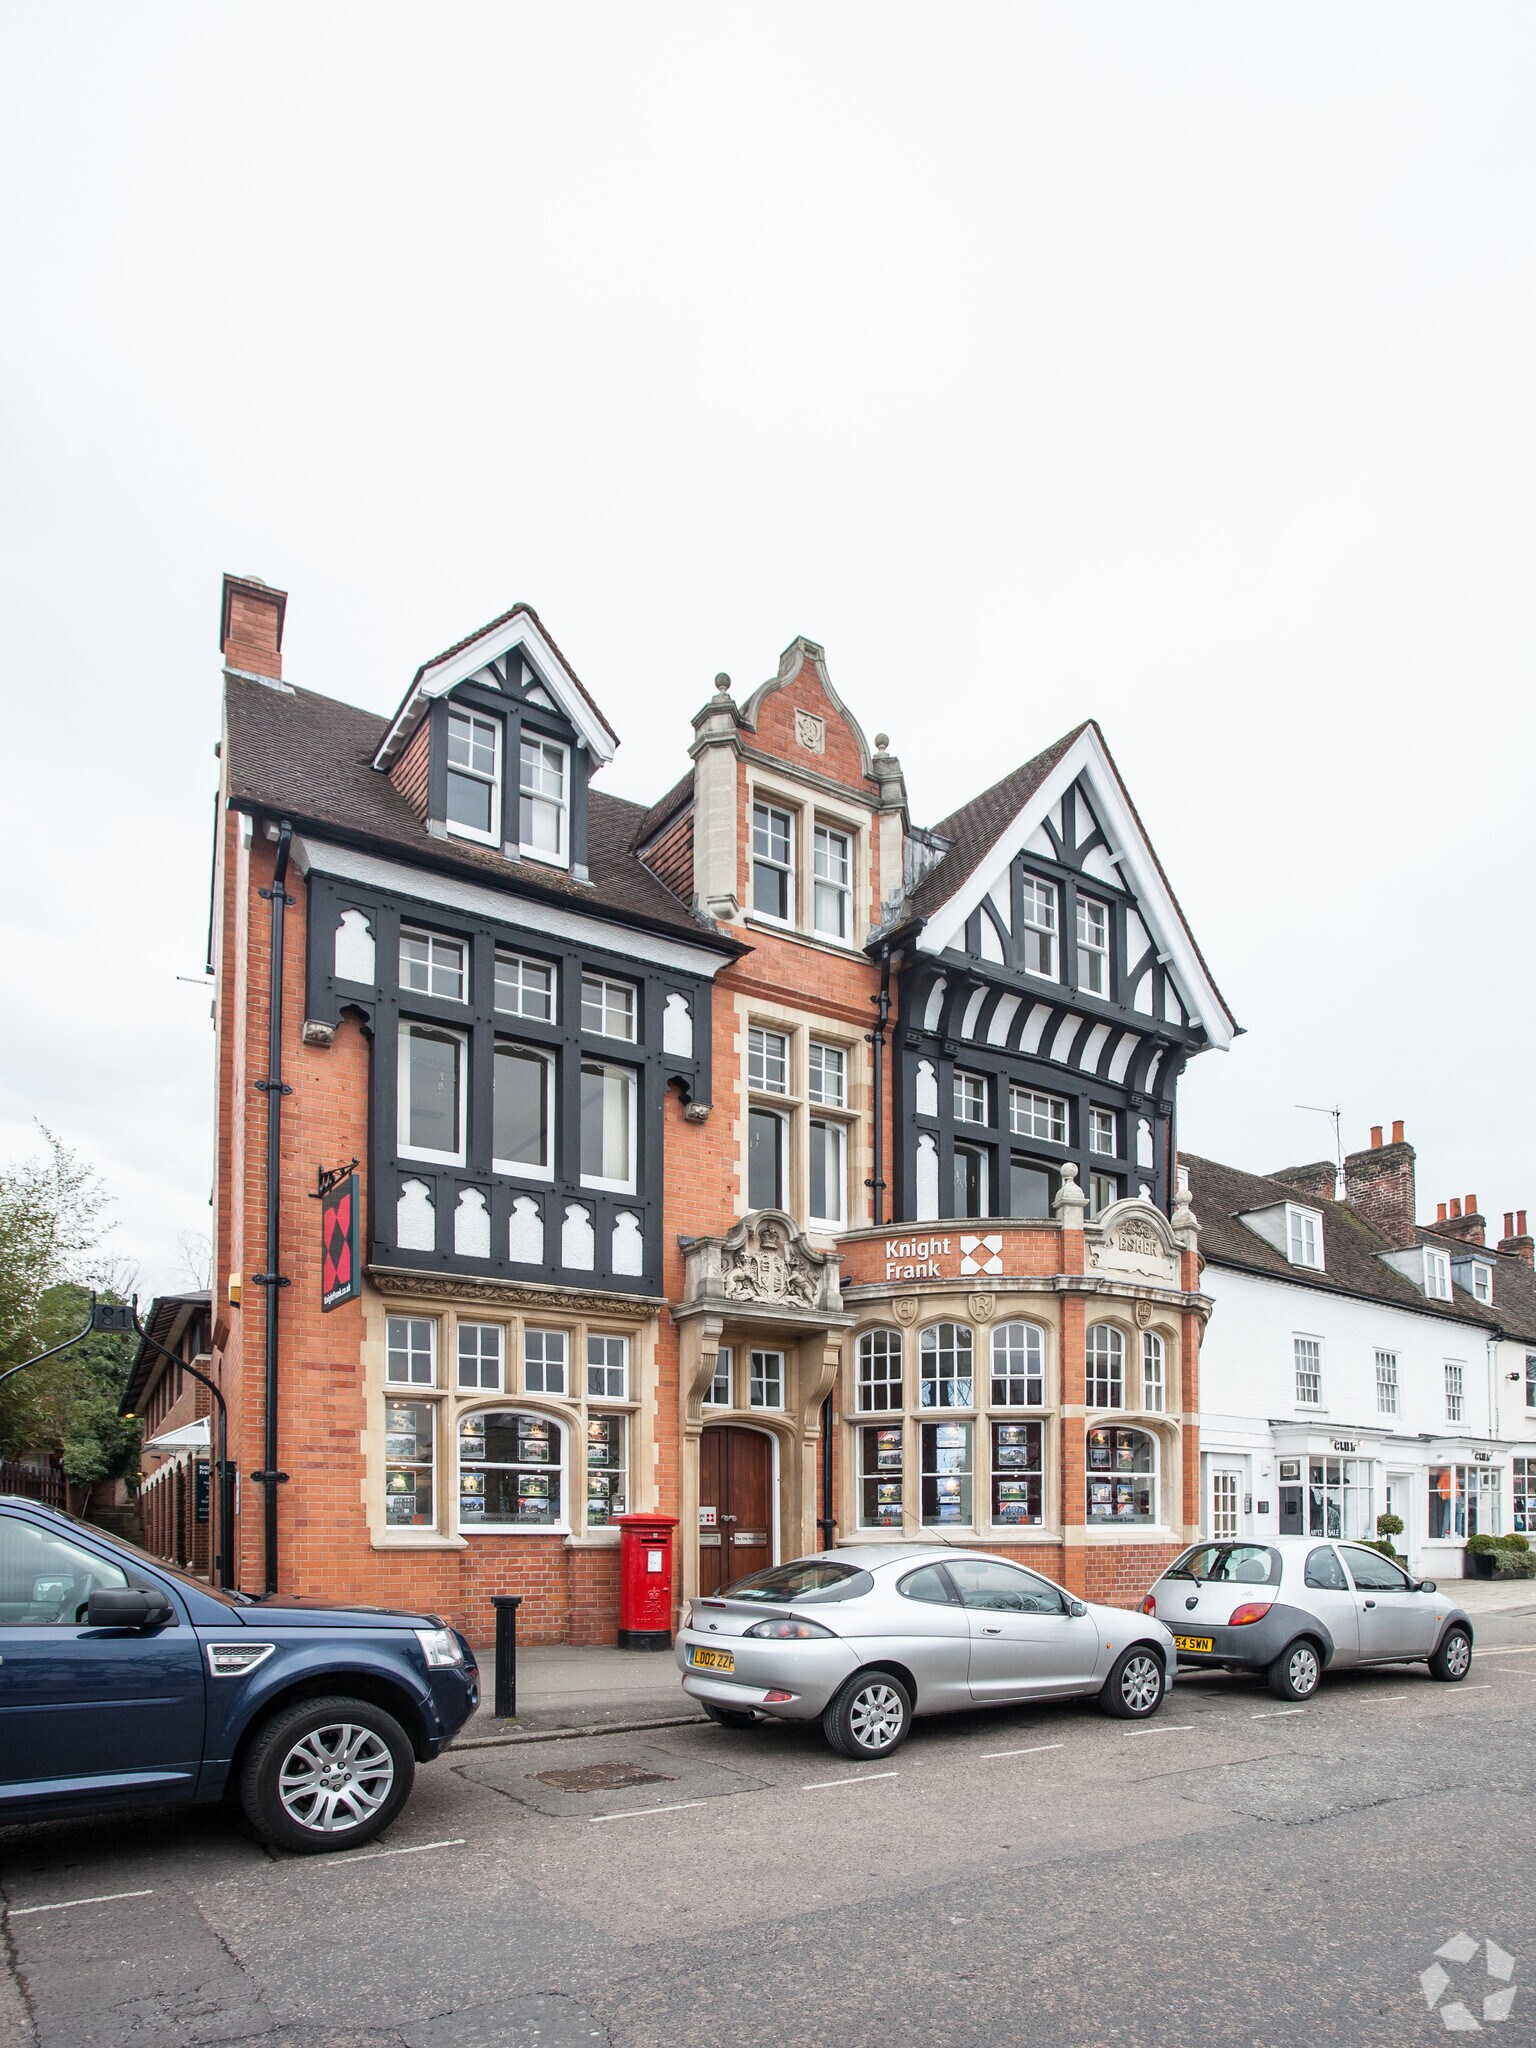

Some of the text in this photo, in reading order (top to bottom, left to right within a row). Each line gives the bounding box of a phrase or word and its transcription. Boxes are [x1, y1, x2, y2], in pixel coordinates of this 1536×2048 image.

[886, 1237, 952, 1261] Knight
[1118, 1236, 1157, 1257] ESHER
[886, 1260, 941, 1280] Frank
[516, 1515, 541, 1523] Lettings
[1327, 1529, 1340, 1537] SALE
[1175, 1637, 1209, 1650] 54 SWN
[694, 1650, 734, 1669] LD02 ZZP
